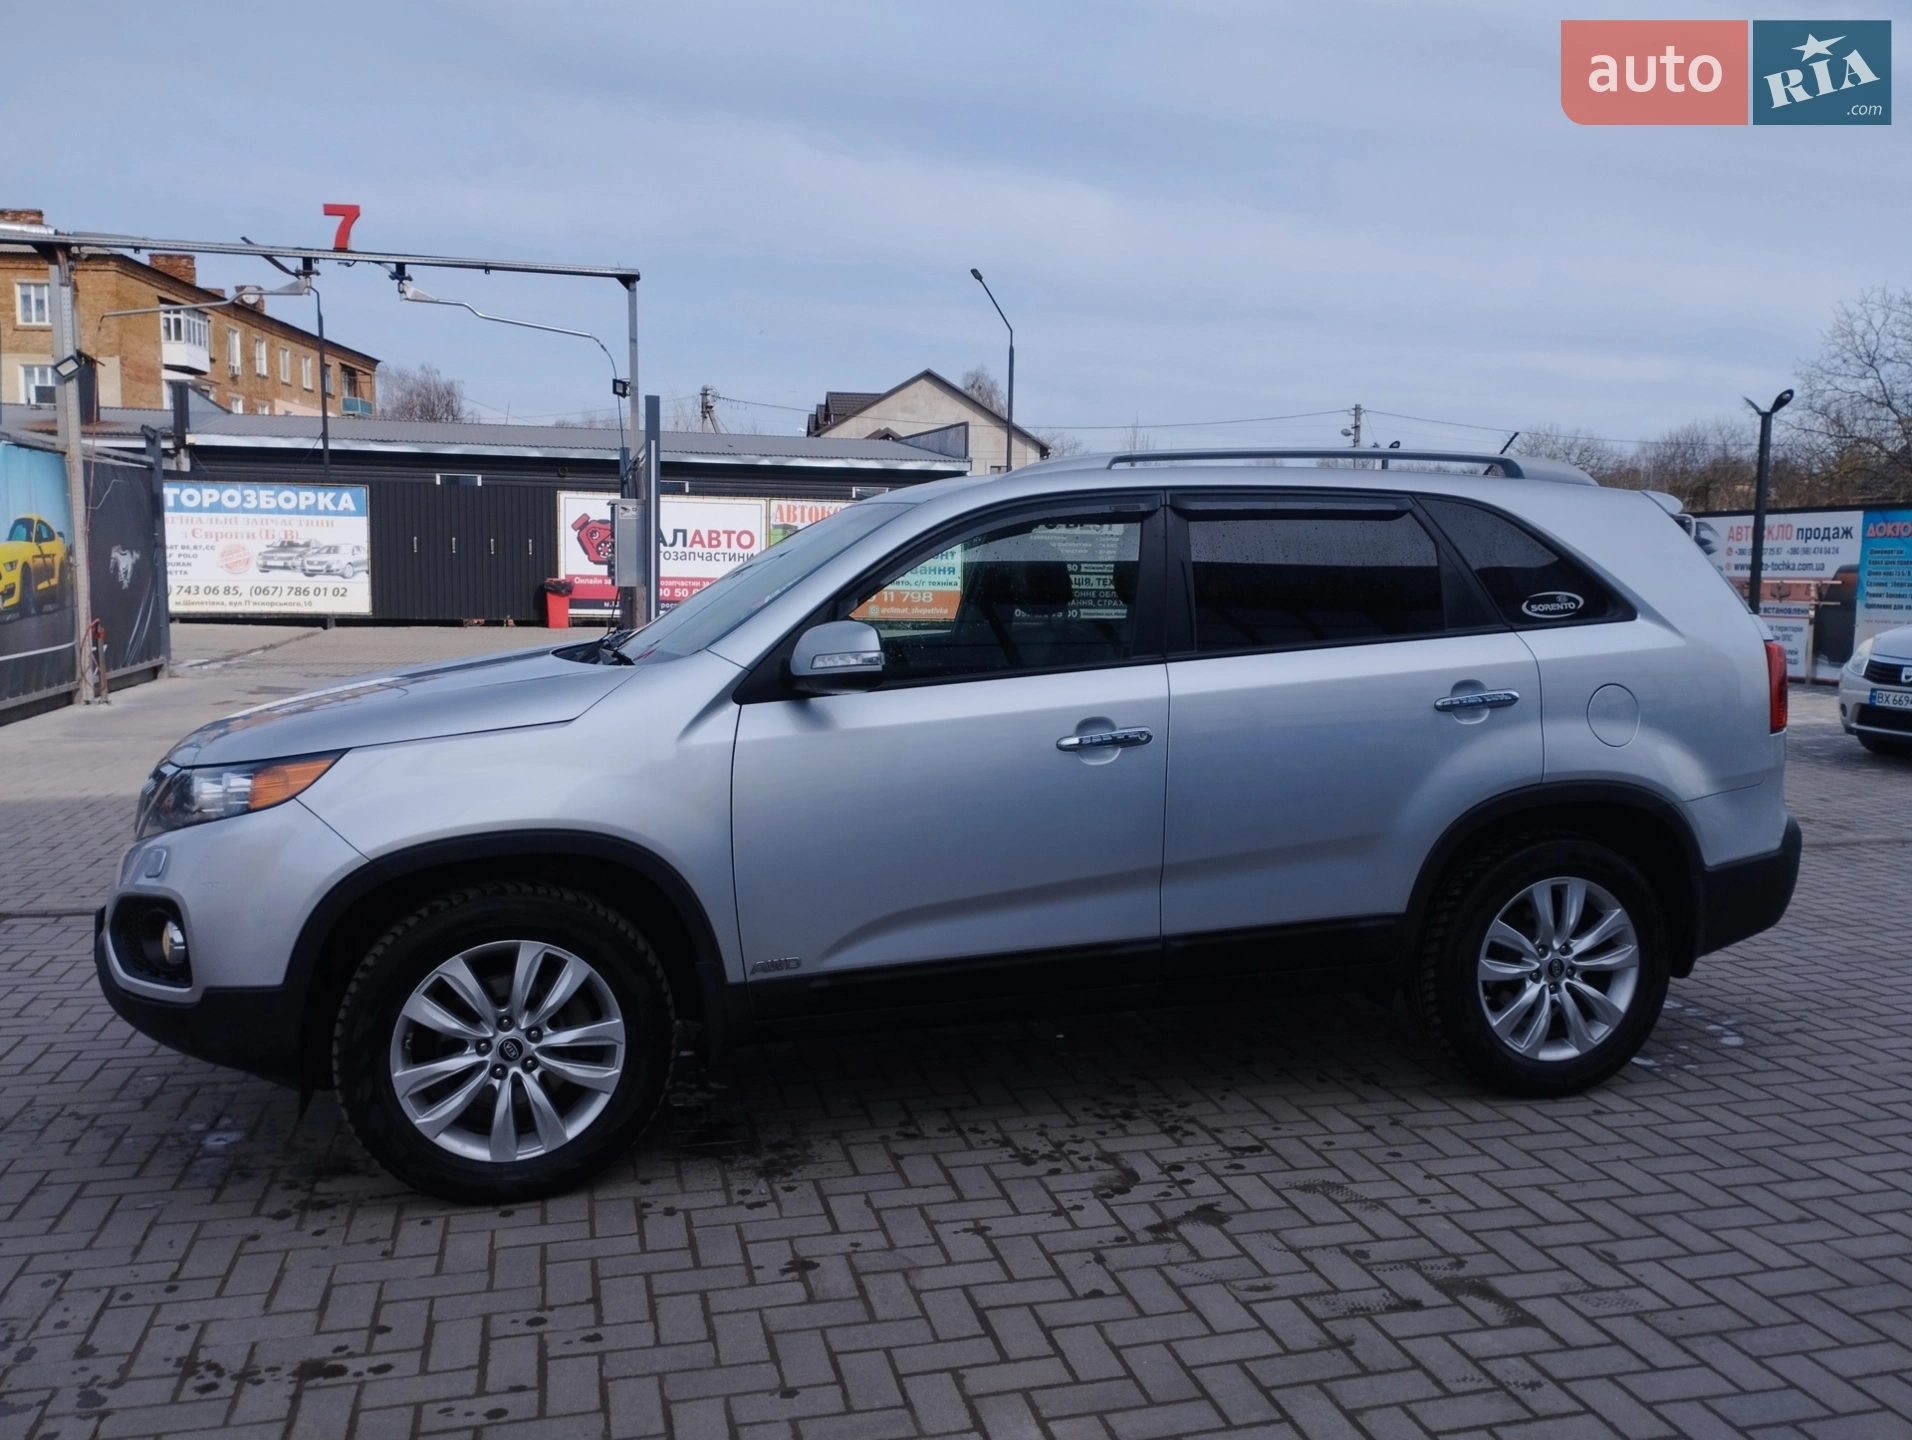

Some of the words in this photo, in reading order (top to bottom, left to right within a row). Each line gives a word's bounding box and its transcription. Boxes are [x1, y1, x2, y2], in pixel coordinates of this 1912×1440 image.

[323, 203, 361, 250] 7
[244, 516, 335, 528] ЗАПЧАСТИНИ
[191, 527, 256, 542] Європи
[1796, 526, 1854, 543] продаж
[1866, 521, 1912, 538] ДОКТО
[574, 576, 603, 585] Онлайн
[928, 580, 958, 588] техніка
[176, 585, 200, 596] 743
[203, 585, 220, 596] 06
[223, 585, 243, 597] 85,
[249, 585, 283, 598] (067)
[286, 586, 310, 597] 786
[313, 586, 328, 597] 01
[332, 586, 348, 598] 02
[674, 588, 689, 598] 50
[881, 591, 895, 602] 11
[900, 591, 933, 603] 798
[1530, 602, 1576, 612] SORENTO
[1892, 694, 1912, 707] 669
[750, 956, 802, 975] AWD
